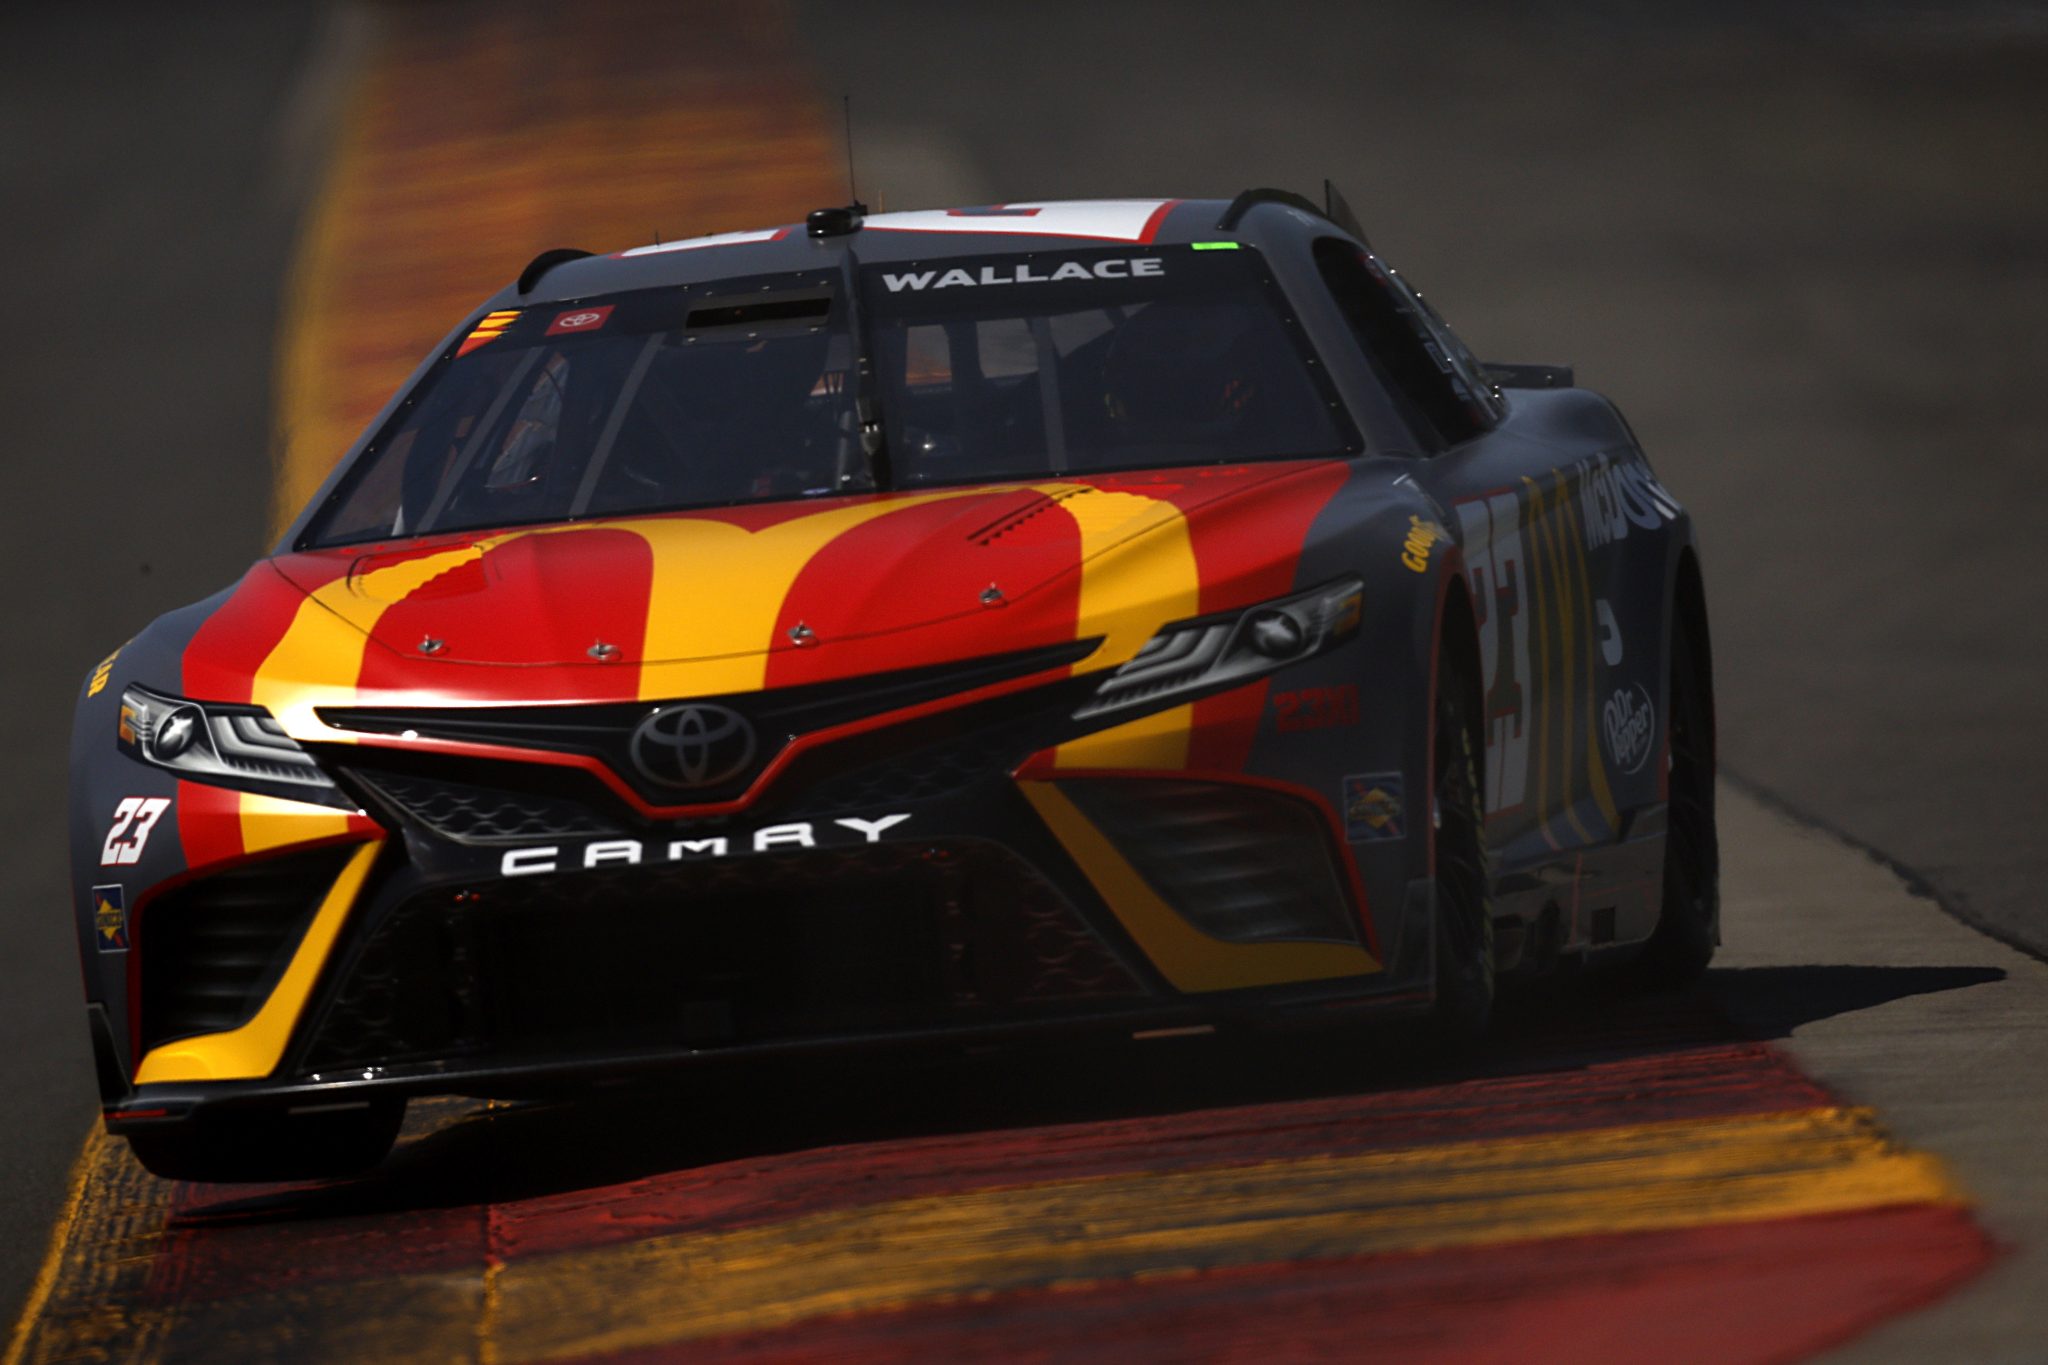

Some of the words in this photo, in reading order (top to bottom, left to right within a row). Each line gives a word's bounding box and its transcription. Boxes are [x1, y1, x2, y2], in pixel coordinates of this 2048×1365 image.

[882, 257, 1165, 292] WALLACE
[1603, 700, 1648, 766] Pepper
[1614, 689, 1632, 728] Dr
[100, 797, 171, 866] 23
[501, 813, 912, 876] CAMRY
